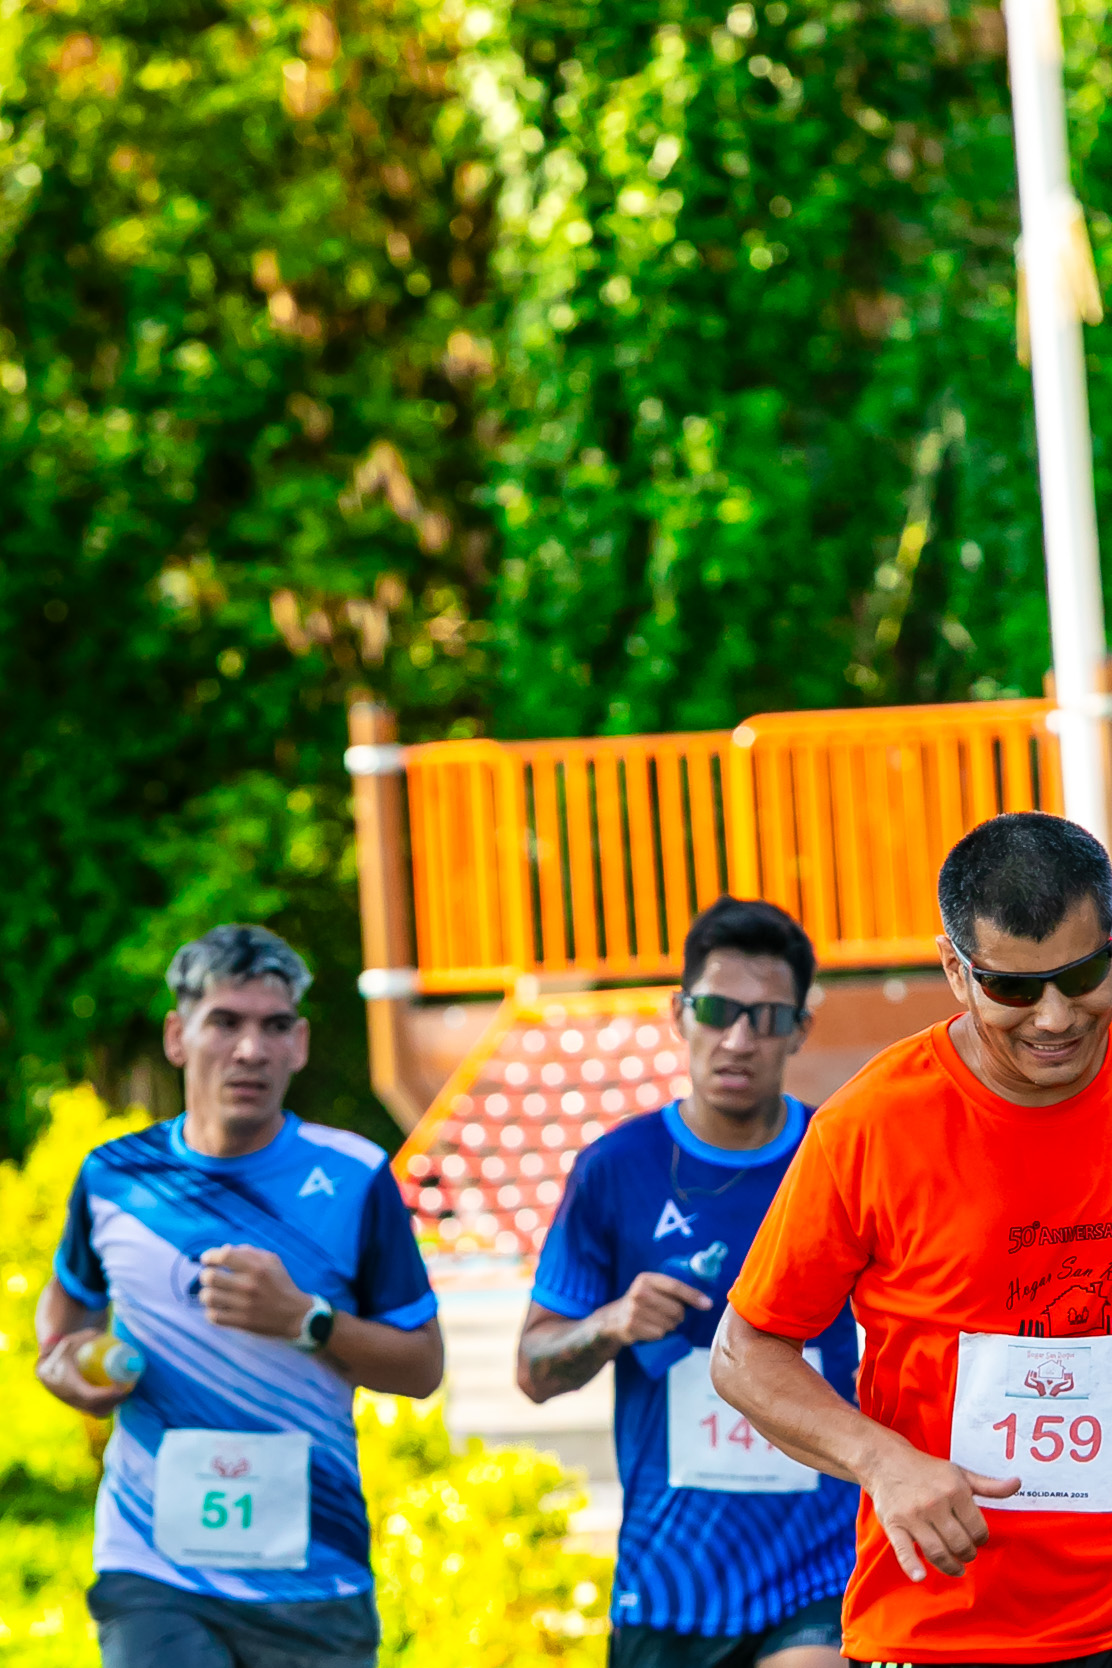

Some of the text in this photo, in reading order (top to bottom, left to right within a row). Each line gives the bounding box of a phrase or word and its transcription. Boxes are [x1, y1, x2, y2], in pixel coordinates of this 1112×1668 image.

[1006, 1274, 1052, 1311] Hogar
[1057, 1256, 1094, 1280] San
[699, 1412, 776, 1453] 14
[992, 1412, 1103, 1463] 159
[201, 1491, 254, 1530] 51
[1026, 1490, 1069, 1498] SOLIDARIA
[1070, 1491, 1089, 1499] 2025
